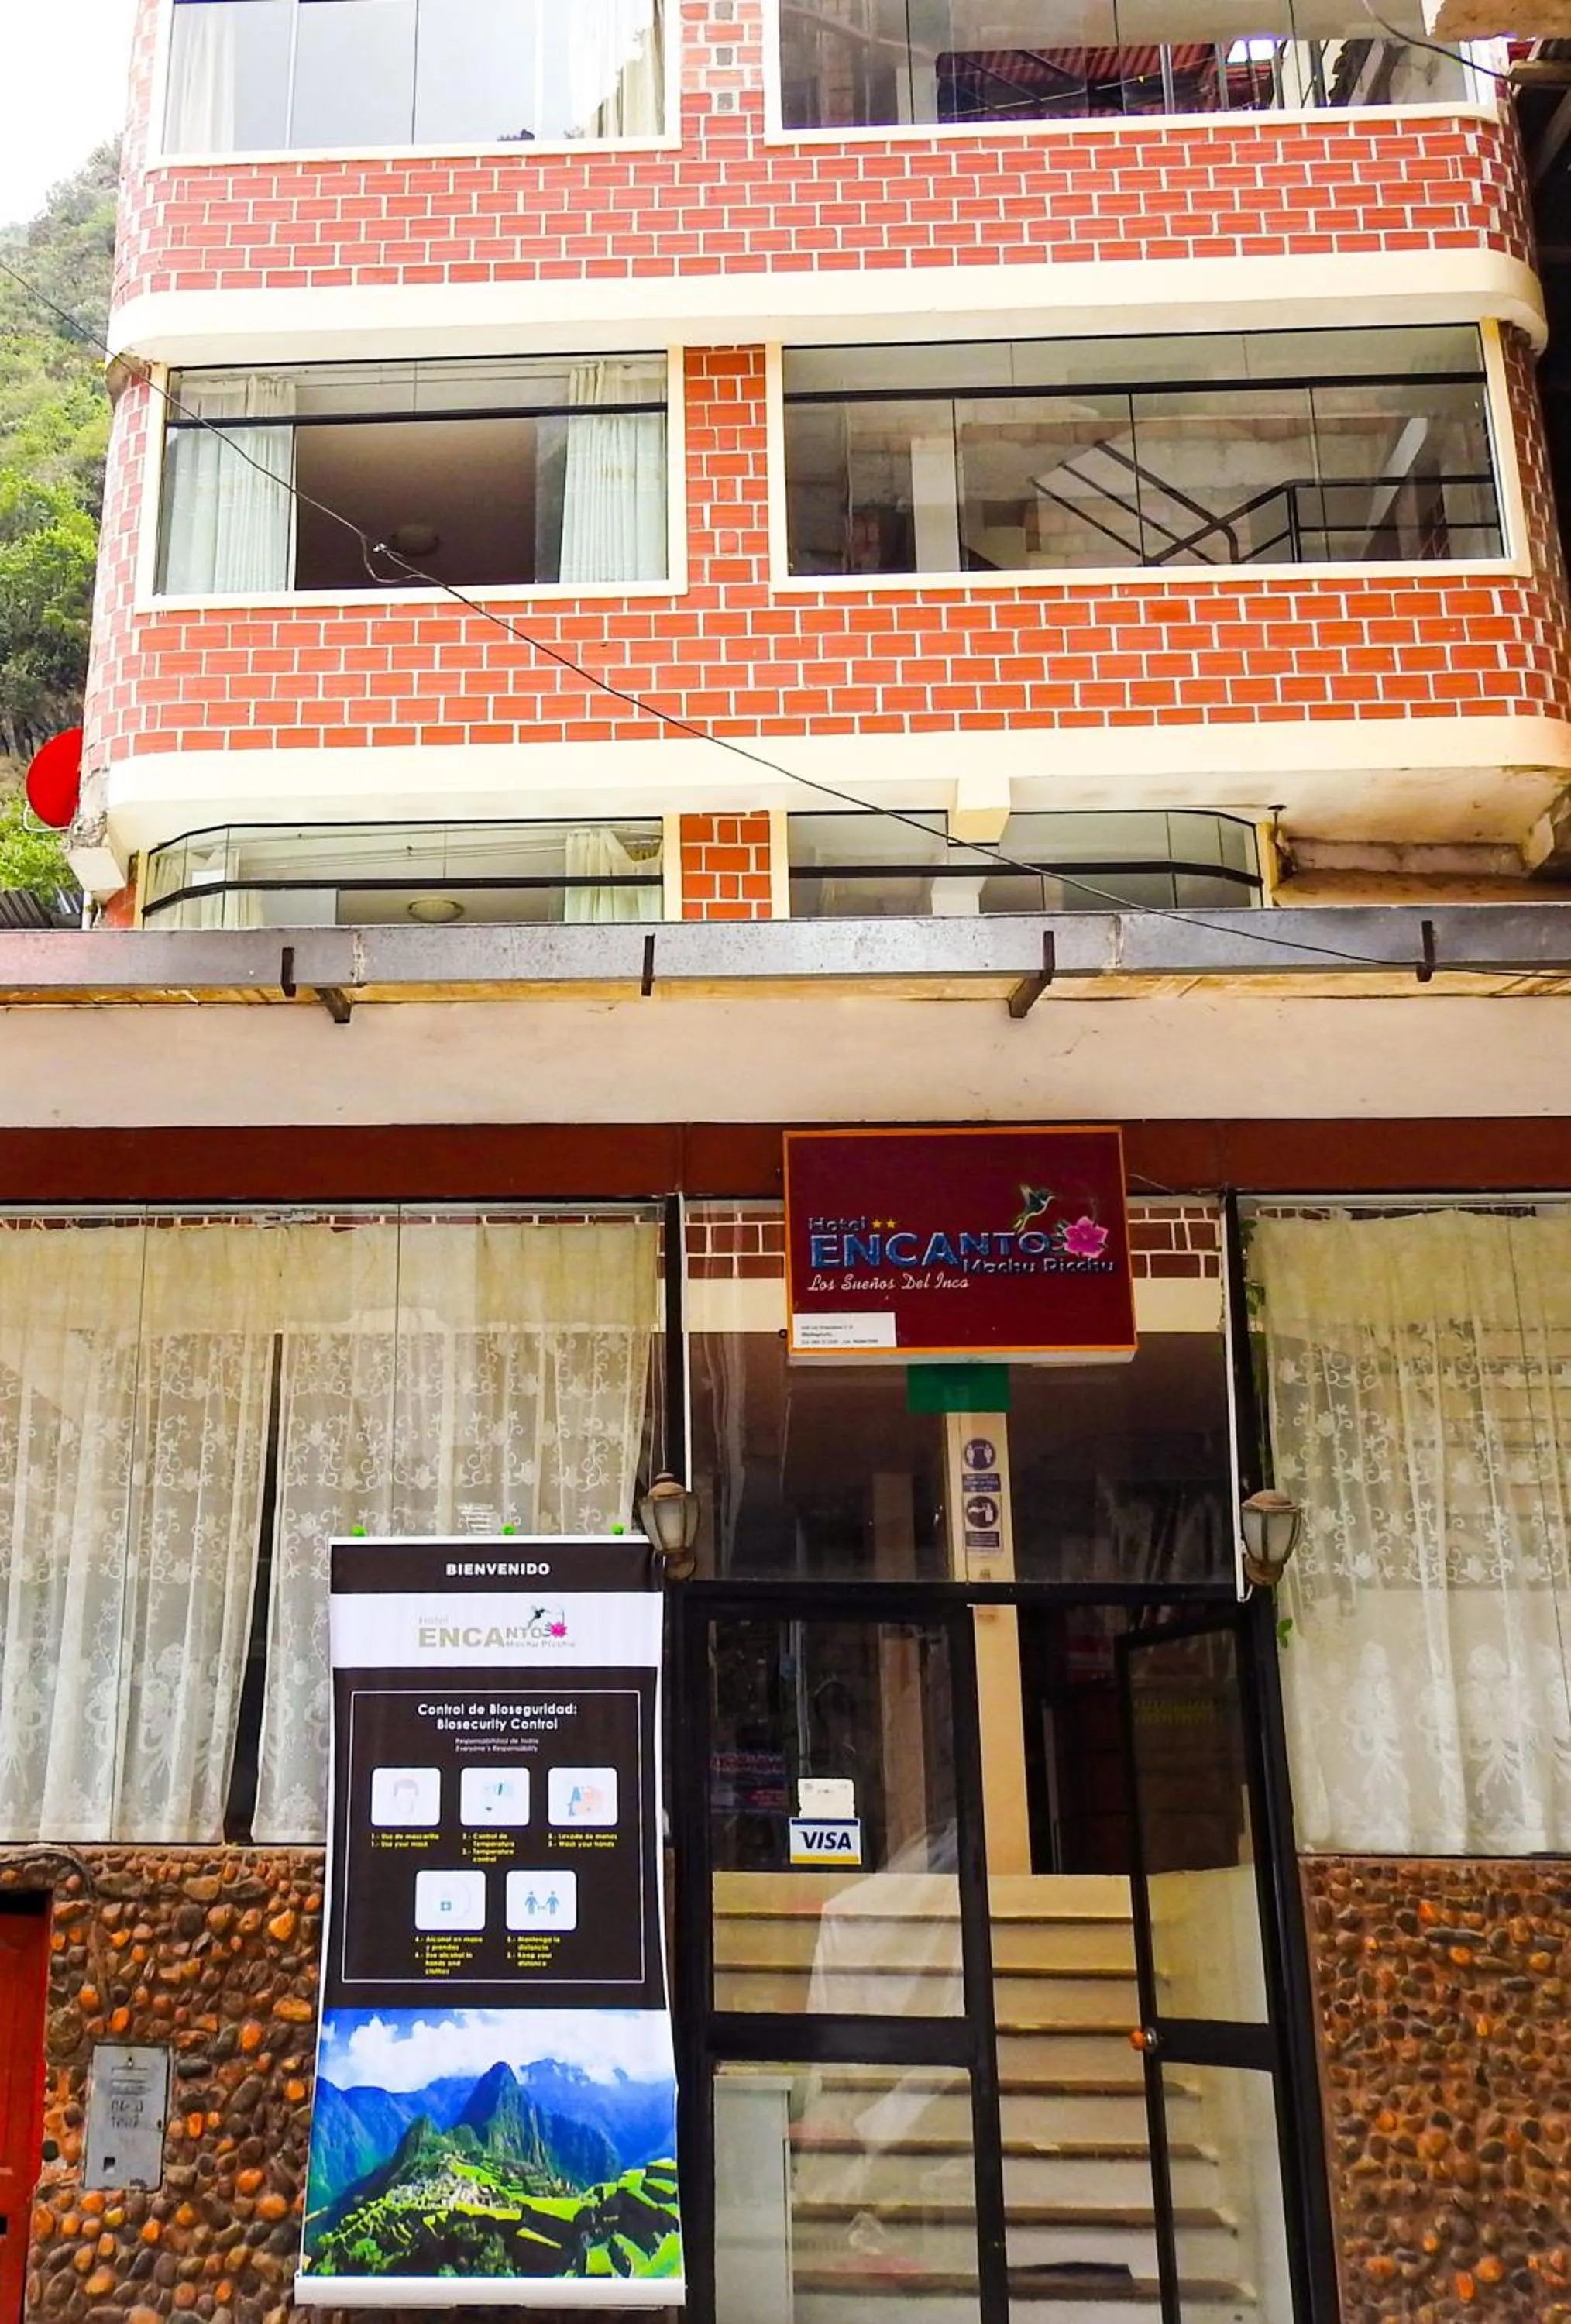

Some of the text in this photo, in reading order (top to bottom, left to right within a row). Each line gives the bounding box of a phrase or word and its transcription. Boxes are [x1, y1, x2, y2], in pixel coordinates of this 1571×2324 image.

[808, 1216, 865, 1231] Hotel
[810, 1232, 1050, 1268] ENCANTO
[807, 1272, 969, 1291] Los Sueños Del Inca
[446, 1563, 550, 1576] BIENVENIDO
[418, 1626, 541, 1648] ENCANTO
[418, 1703, 578, 1718] Control de Bioseguridad:
[436, 1717, 558, 1731] Biosecurity Control
[799, 1831, 851, 1850] VISA
